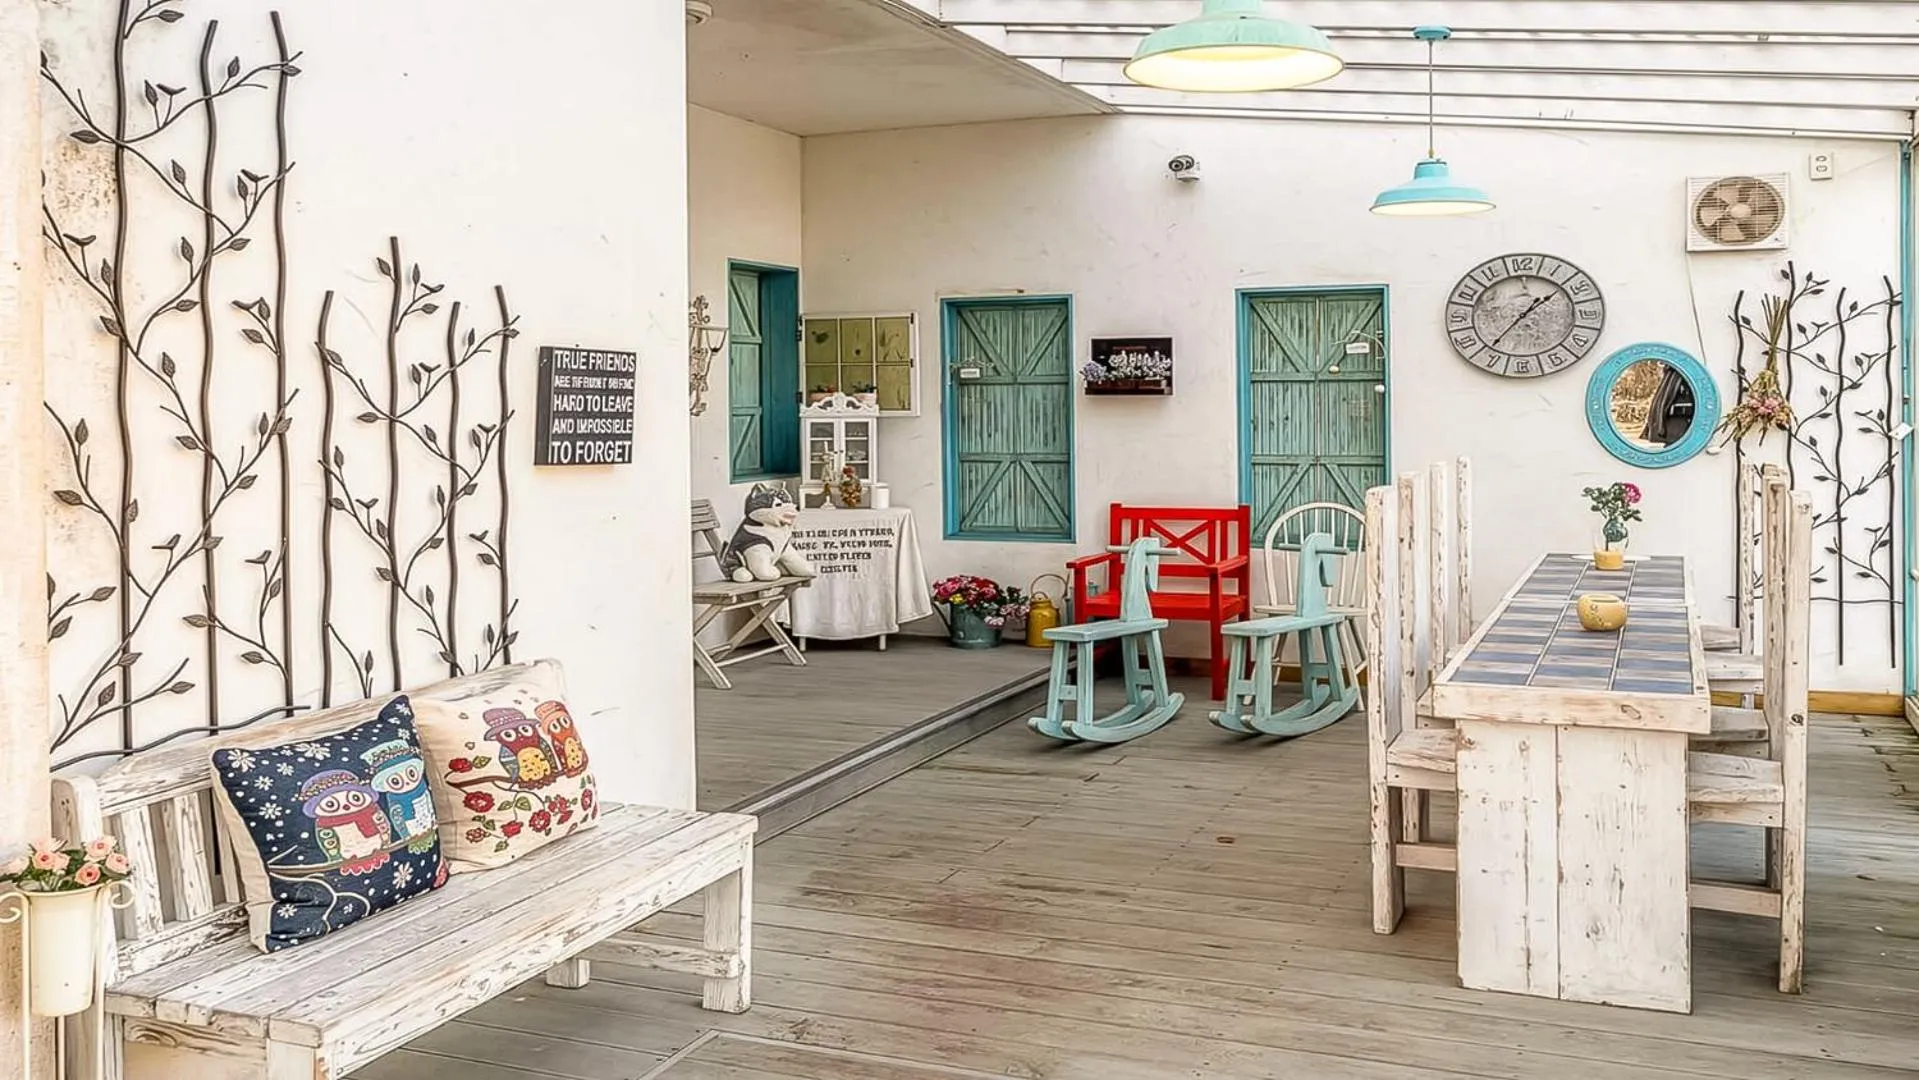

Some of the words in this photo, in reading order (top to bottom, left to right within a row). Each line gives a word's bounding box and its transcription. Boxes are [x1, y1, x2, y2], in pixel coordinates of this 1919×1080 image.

[554, 350, 588, 369] TRUE
[589, 352, 635, 372] FRIENDS
[553, 394, 584, 412] HARD
[586, 395, 600, 412] TO
[602, 395, 633, 412] LEAVE
[552, 418, 575, 434] AND
[576, 418, 633, 434] IMPOSSIBLE
[551, 441, 572, 463] TO
[575, 441, 631, 463] FORGET
